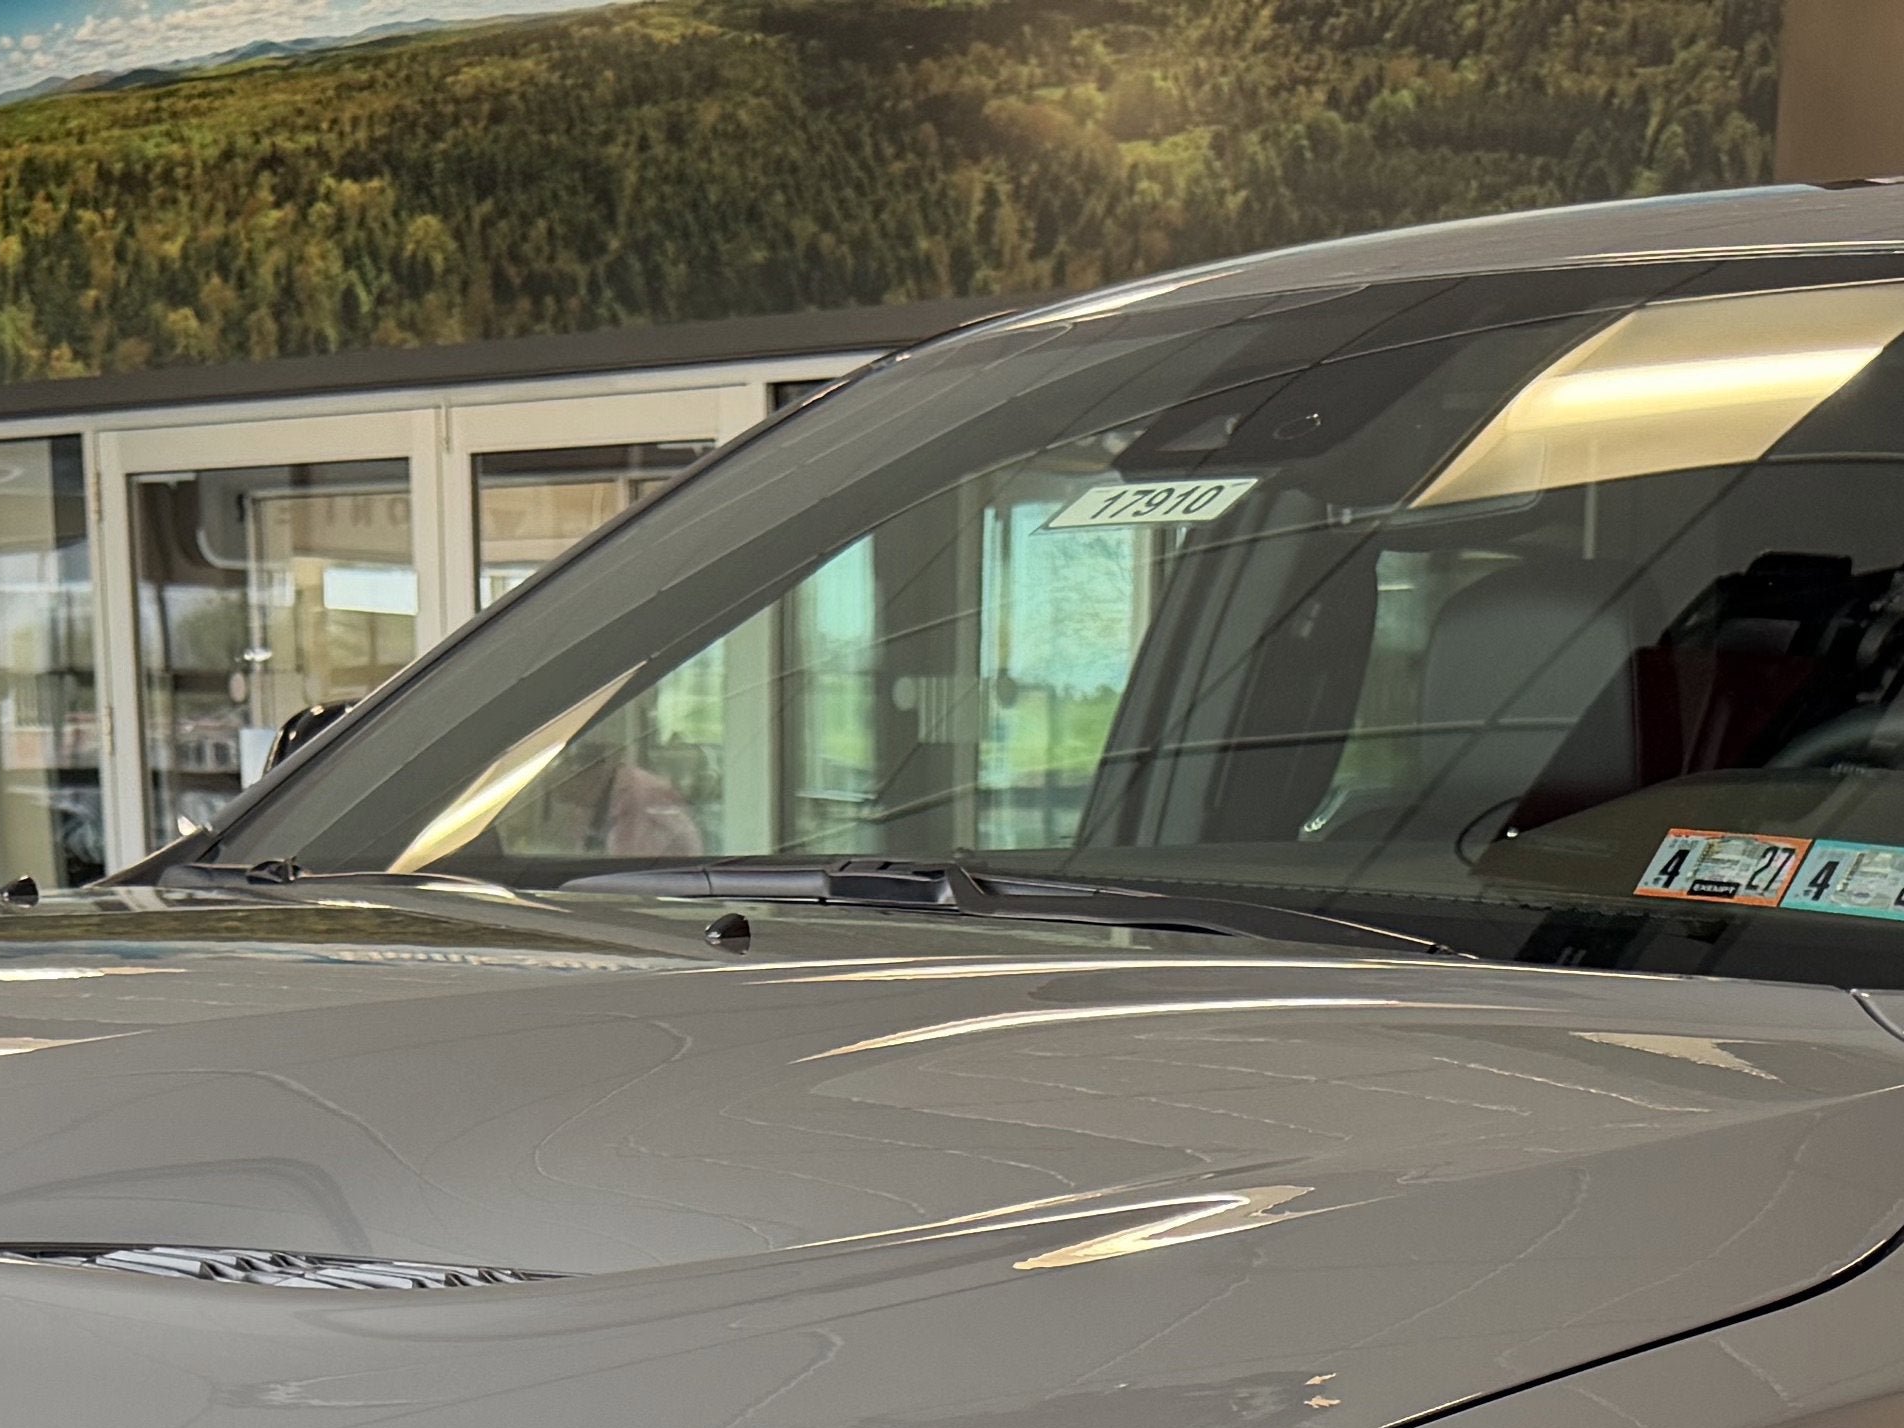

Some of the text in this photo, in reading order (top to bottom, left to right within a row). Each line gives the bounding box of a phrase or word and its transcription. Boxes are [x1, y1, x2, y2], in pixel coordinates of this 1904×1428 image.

[1090, 485, 1225, 520] 17910
[1659, 845, 1796, 892] 4 27
[1808, 860, 1840, 901] 4
[1692, 883, 1736, 895] EXEMPT
